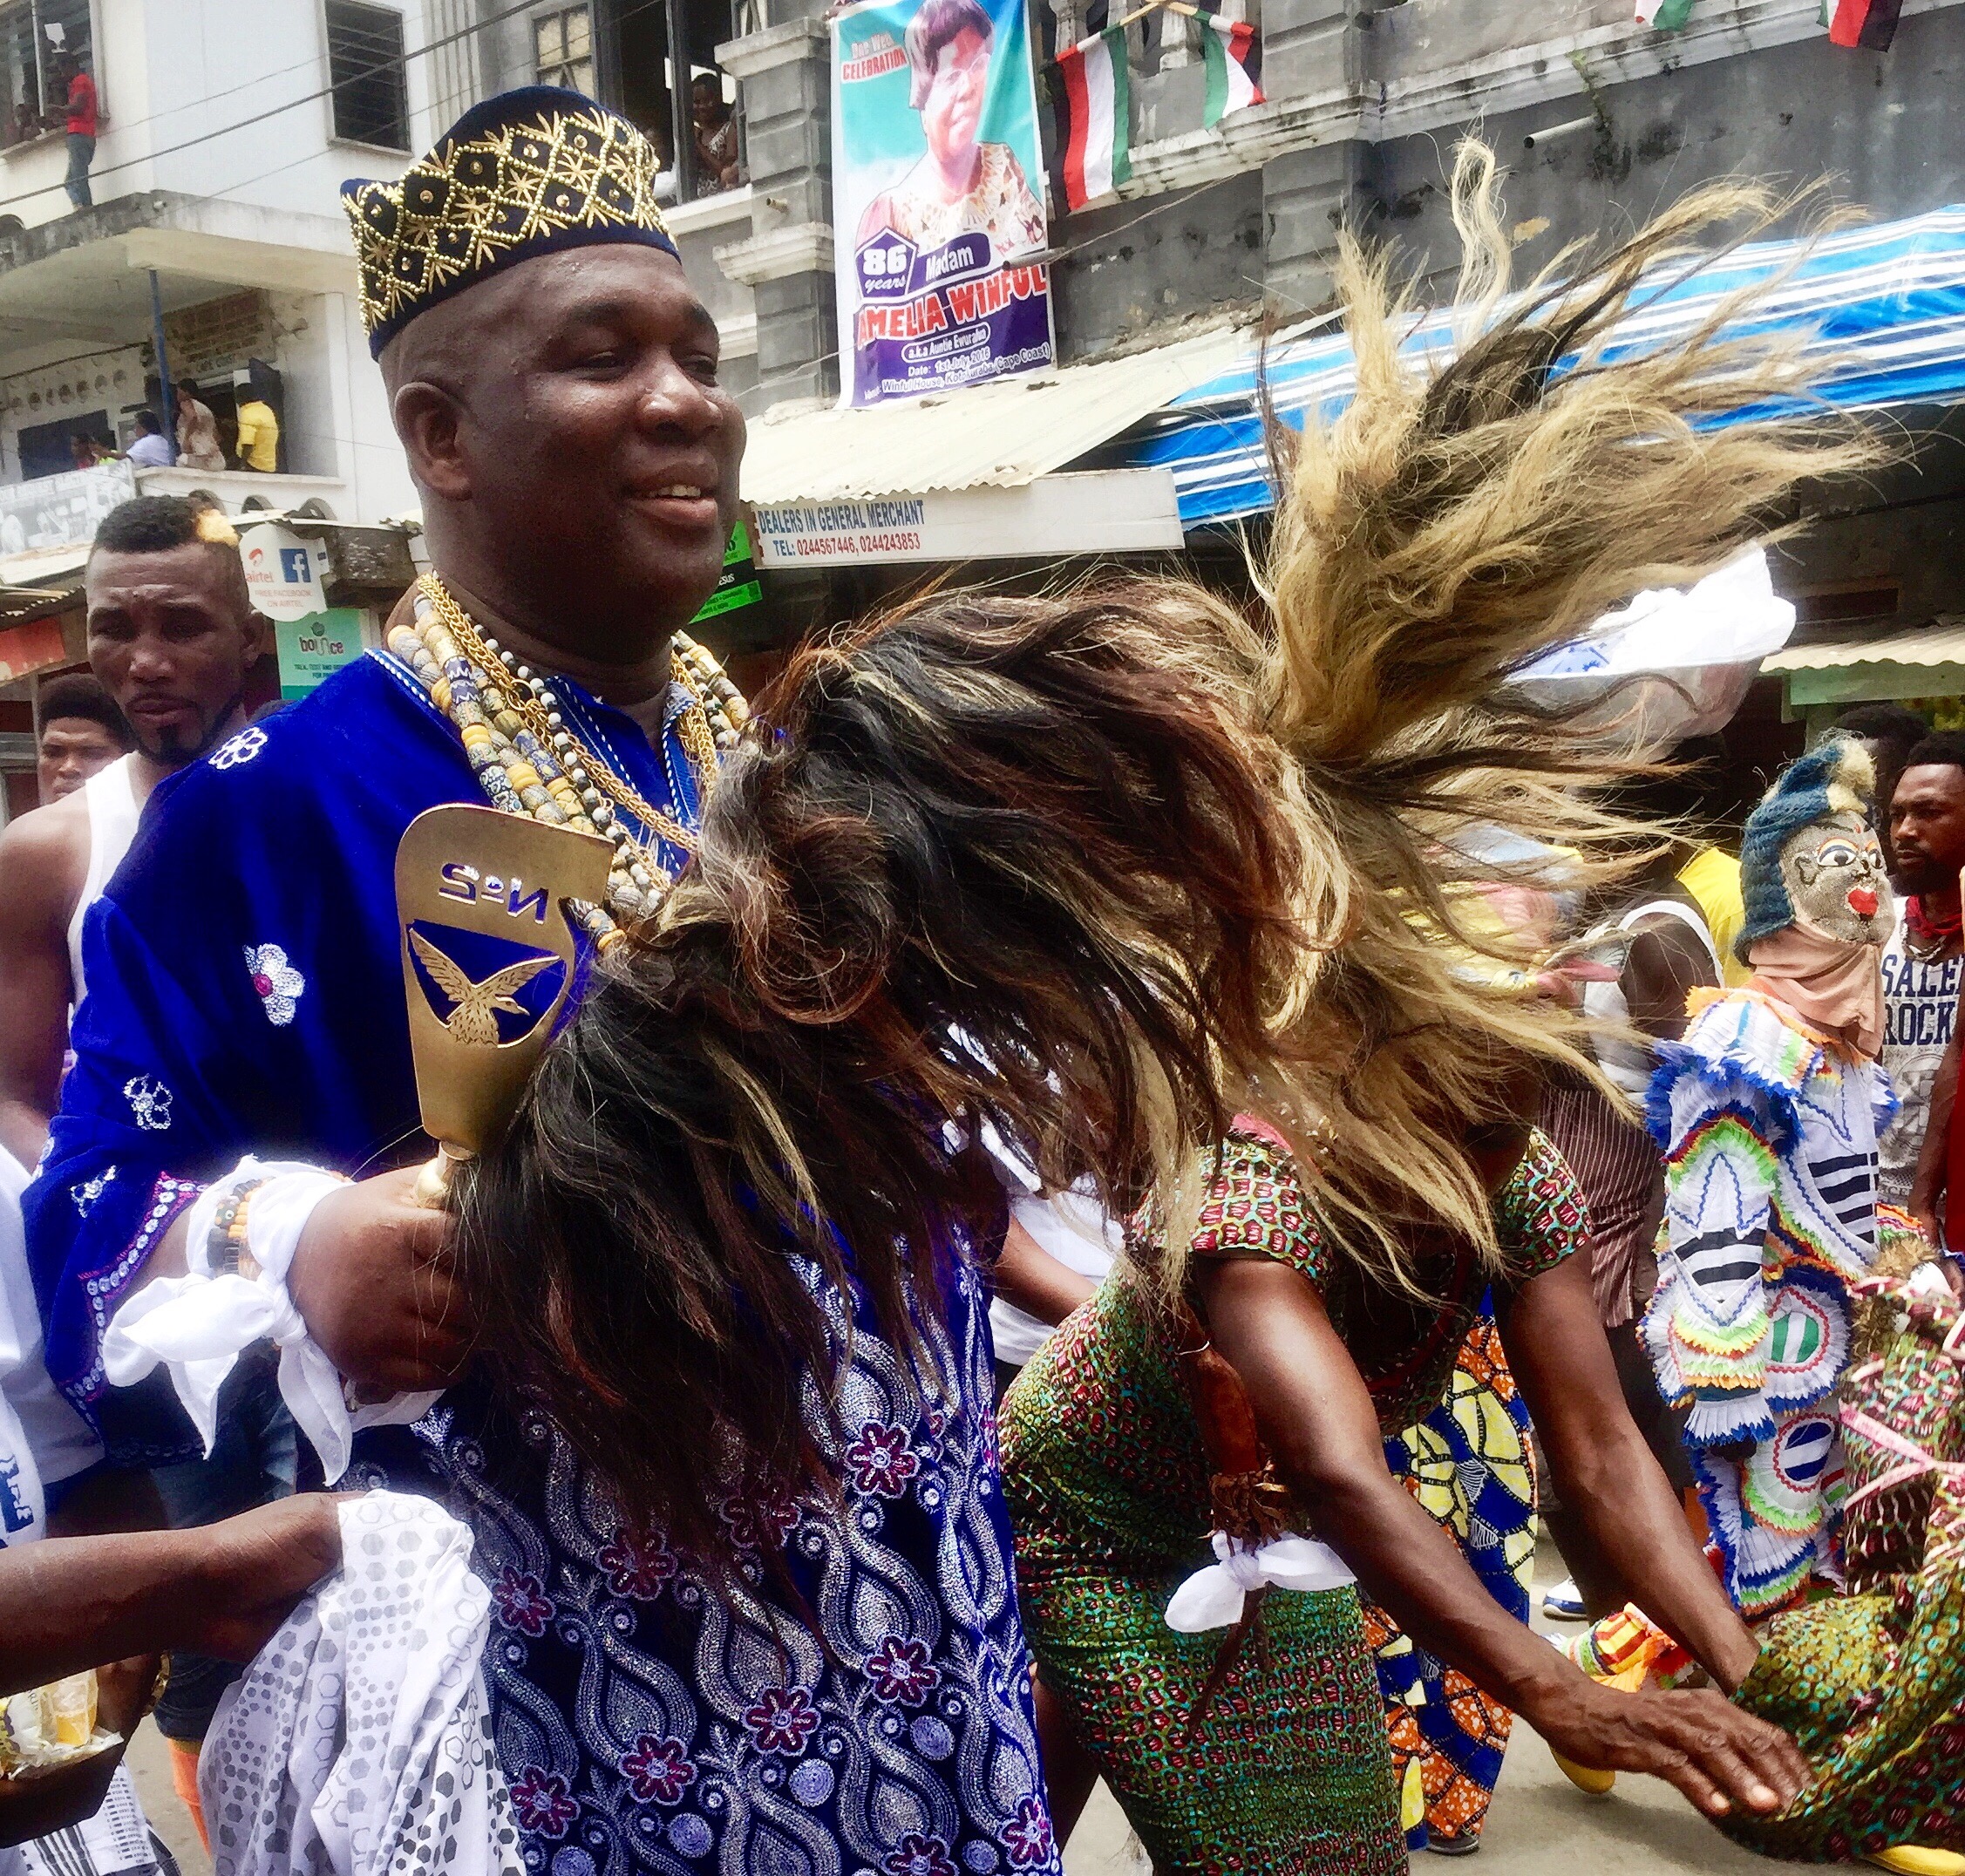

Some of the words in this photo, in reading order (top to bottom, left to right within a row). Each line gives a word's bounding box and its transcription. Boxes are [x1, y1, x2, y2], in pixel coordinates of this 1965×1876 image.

[843, 47, 907, 80] CELEBRATION
[863, 244, 907, 275] 86
[926, 246, 974, 281] Madam
[864, 275, 907, 294] years
[857, 294, 949, 347] AMELIA
[948, 264, 1047, 324] WINFUL
[882, 378, 912, 393] Winful
[1019, 342, 1051, 363] Coast)
[908, 365, 932, 377] Date:
[758, 508, 805, 534] DEALERS
[804, 506, 817, 532] IN
[818, 504, 866, 531] GENERAL
[867, 500, 925, 528] MERCHANT
[773, 540, 796, 556] TEL:
[797, 536, 859, 556] 0244567446,
[860, 532, 921, 553] 0244243853
[246, 571, 274, 583] airtel
[299, 636, 343, 656] bounce
